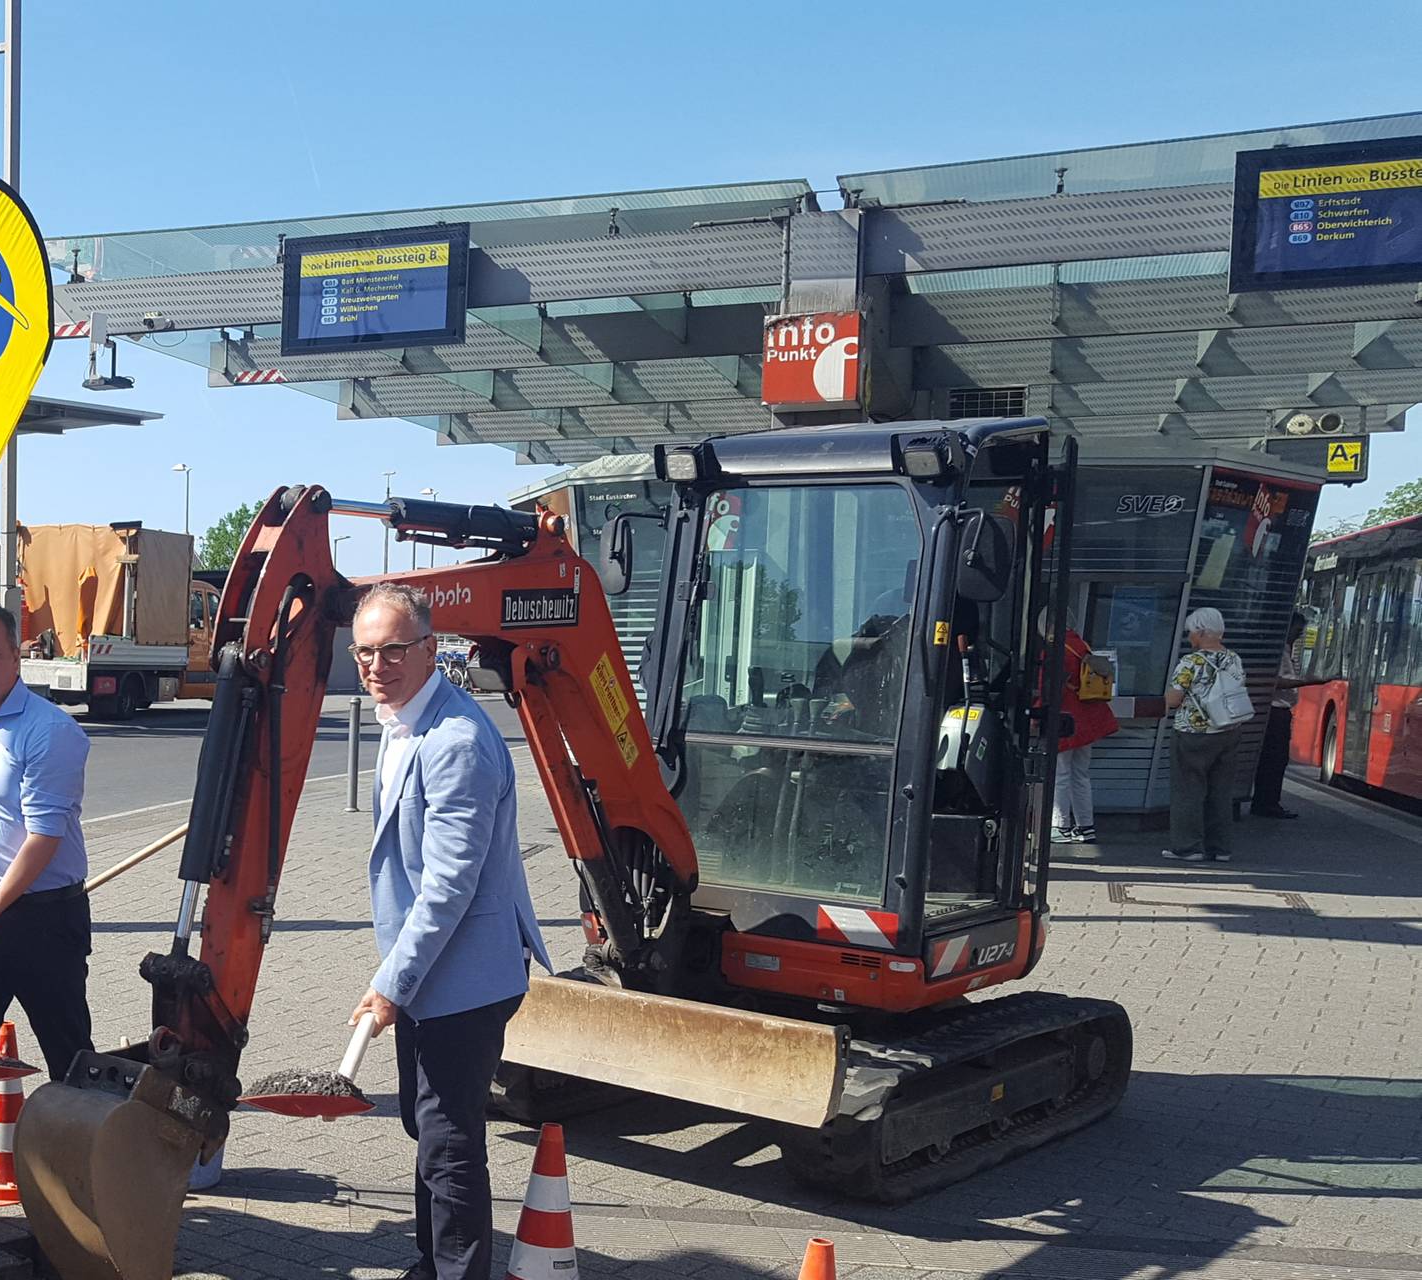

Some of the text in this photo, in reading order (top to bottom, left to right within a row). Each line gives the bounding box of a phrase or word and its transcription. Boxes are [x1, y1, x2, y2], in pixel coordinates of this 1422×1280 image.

[1273, 181, 1289, 190] Die
[1293, 174, 1342, 188] Linien
[1346, 175, 1365, 184] von
[1318, 197, 1361, 207] Erftstadt
[1318, 208, 1369, 218] Schwerfen
[1292, 217, 1392, 231] 865 Oberwichterich
[1292, 231, 1355, 242] 869 Derkum
[324, 257, 359, 269] Linien
[376, 250, 426, 265] Bussteig
[429, 249, 437, 261] B
[356, 274, 399, 284] Münstereifel
[340, 293, 399, 303] Kreuzweingarten
[767, 346, 817, 362] Punkt
[1117, 495, 1165, 514] SVE
[505, 594, 575, 621] Debuschewitz
[978, 942, 1015, 965] U27-4
